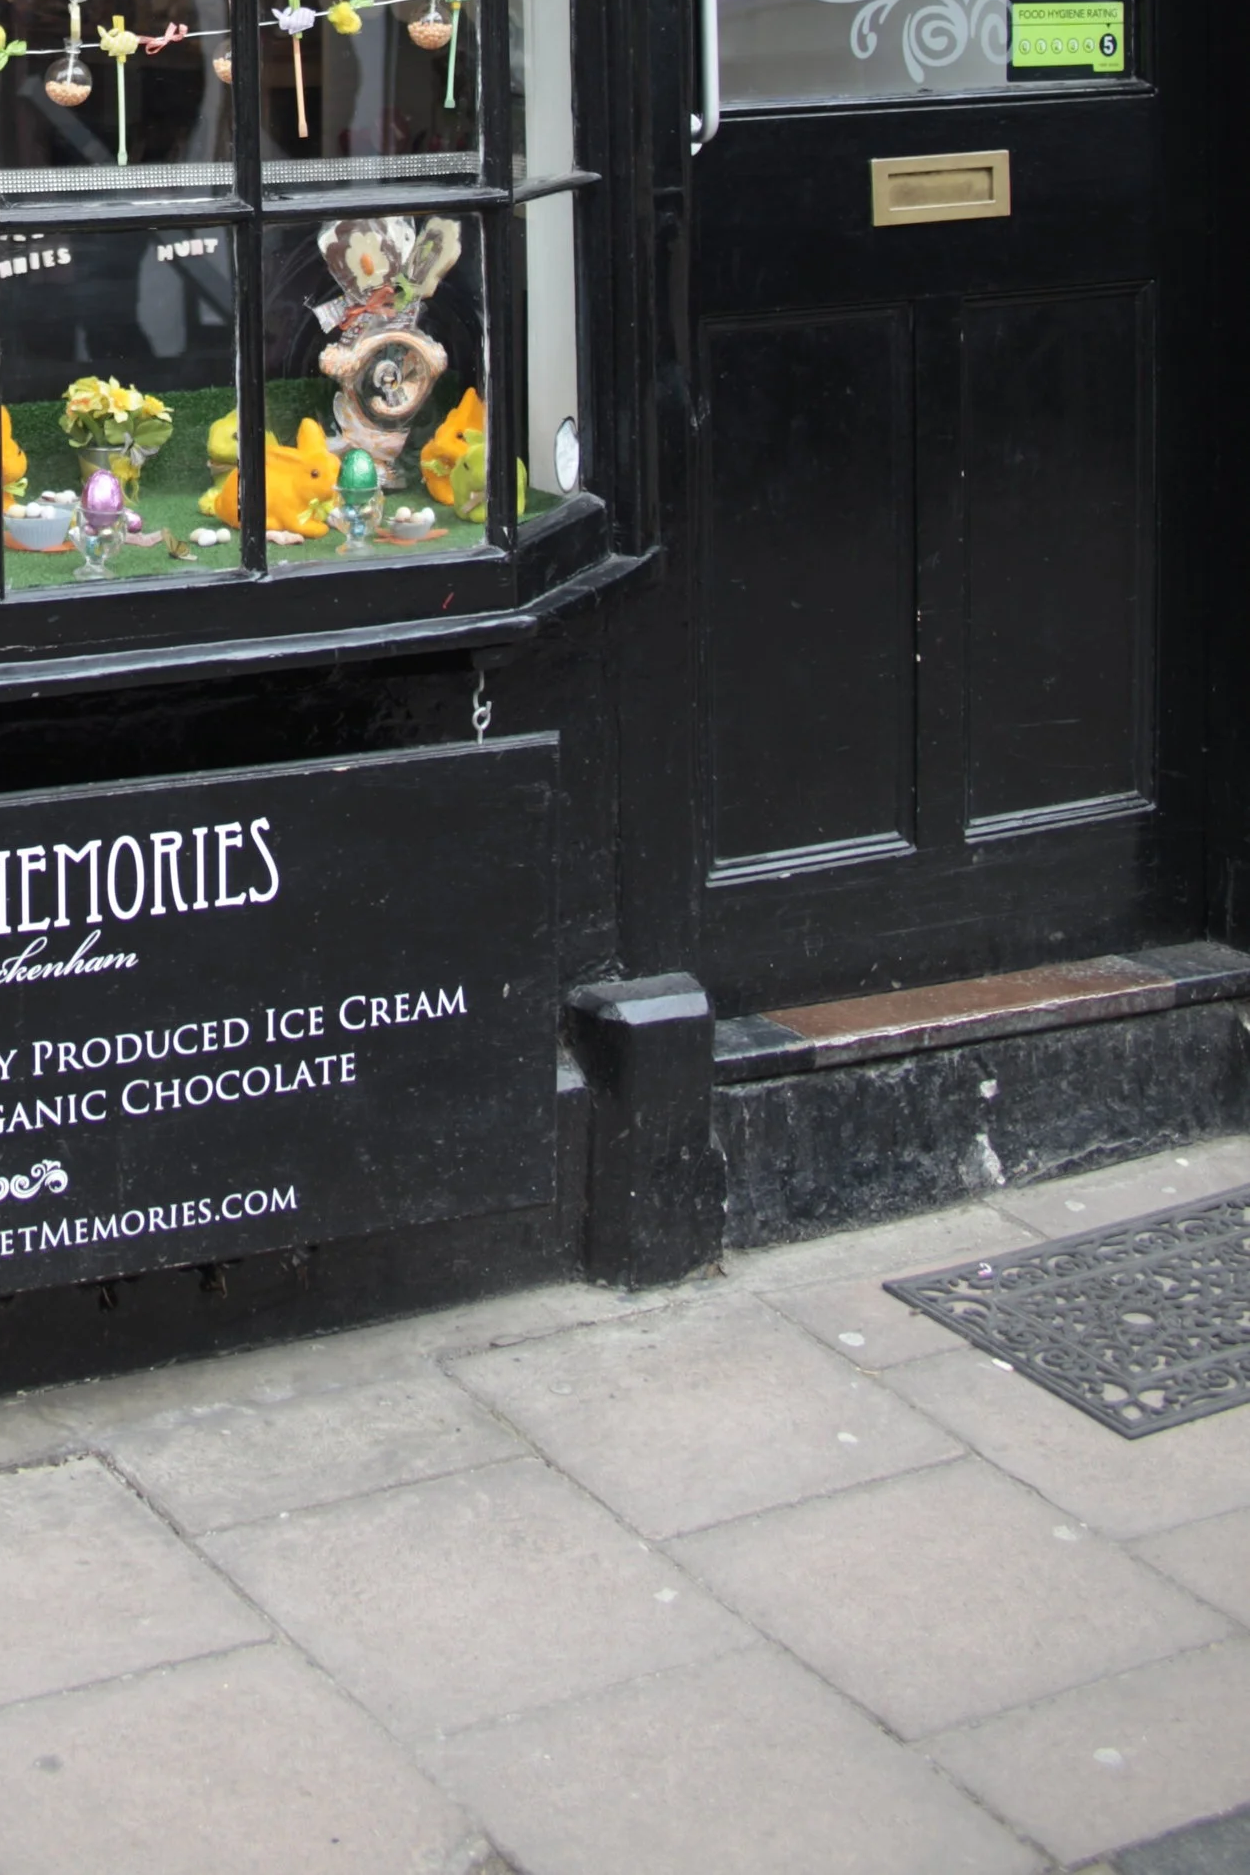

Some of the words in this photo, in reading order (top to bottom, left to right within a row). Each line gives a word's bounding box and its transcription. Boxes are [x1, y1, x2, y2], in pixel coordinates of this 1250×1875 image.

[1018, 9, 1046, 20] FOOD
[1047, 9, 1086, 19] HYGIENE
[1086, 8, 1118, 19] RATING
[1103, 35, 1114, 55] 5
[31, 1017, 250, 1076] PRODUCED
[265, 1005, 325, 1043] ICE
[338, 985, 468, 1031] CREAM
[121, 1052, 356, 1115] CHOCOLATE
